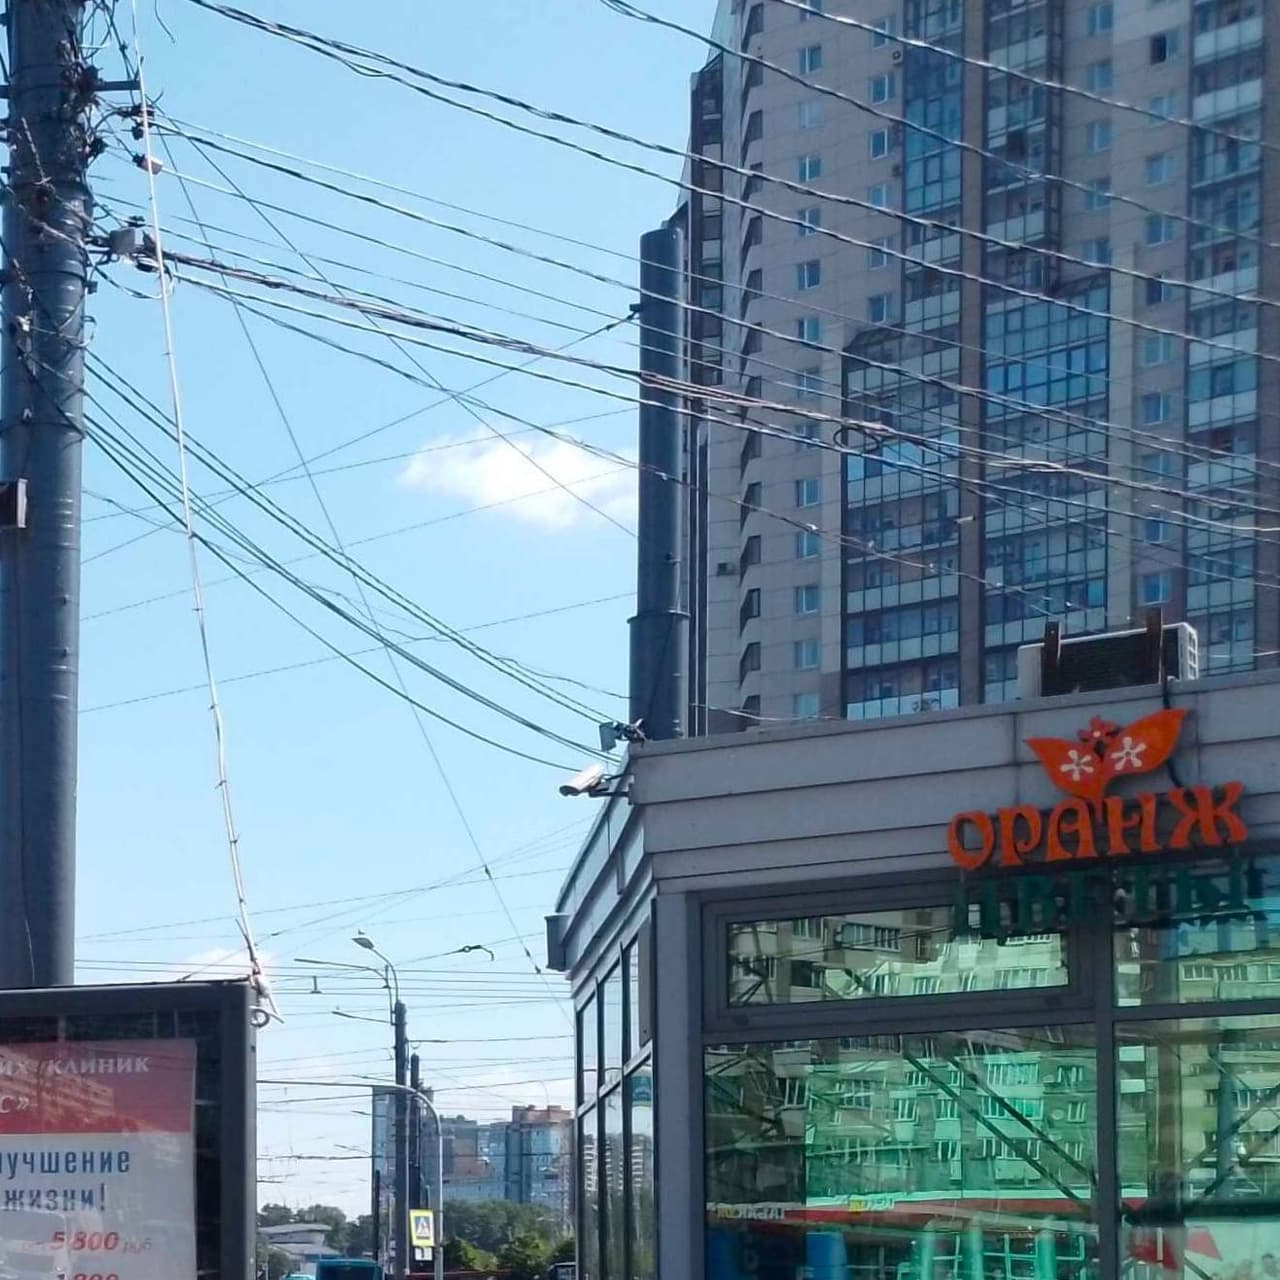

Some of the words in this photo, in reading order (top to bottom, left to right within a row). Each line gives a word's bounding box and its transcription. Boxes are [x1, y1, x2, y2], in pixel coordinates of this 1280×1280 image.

[947, 781, 1248, 870] ОРАНЖ
[47, 1055, 152, 1075] клиник
[3, 1183, 107, 1213] жизни!
